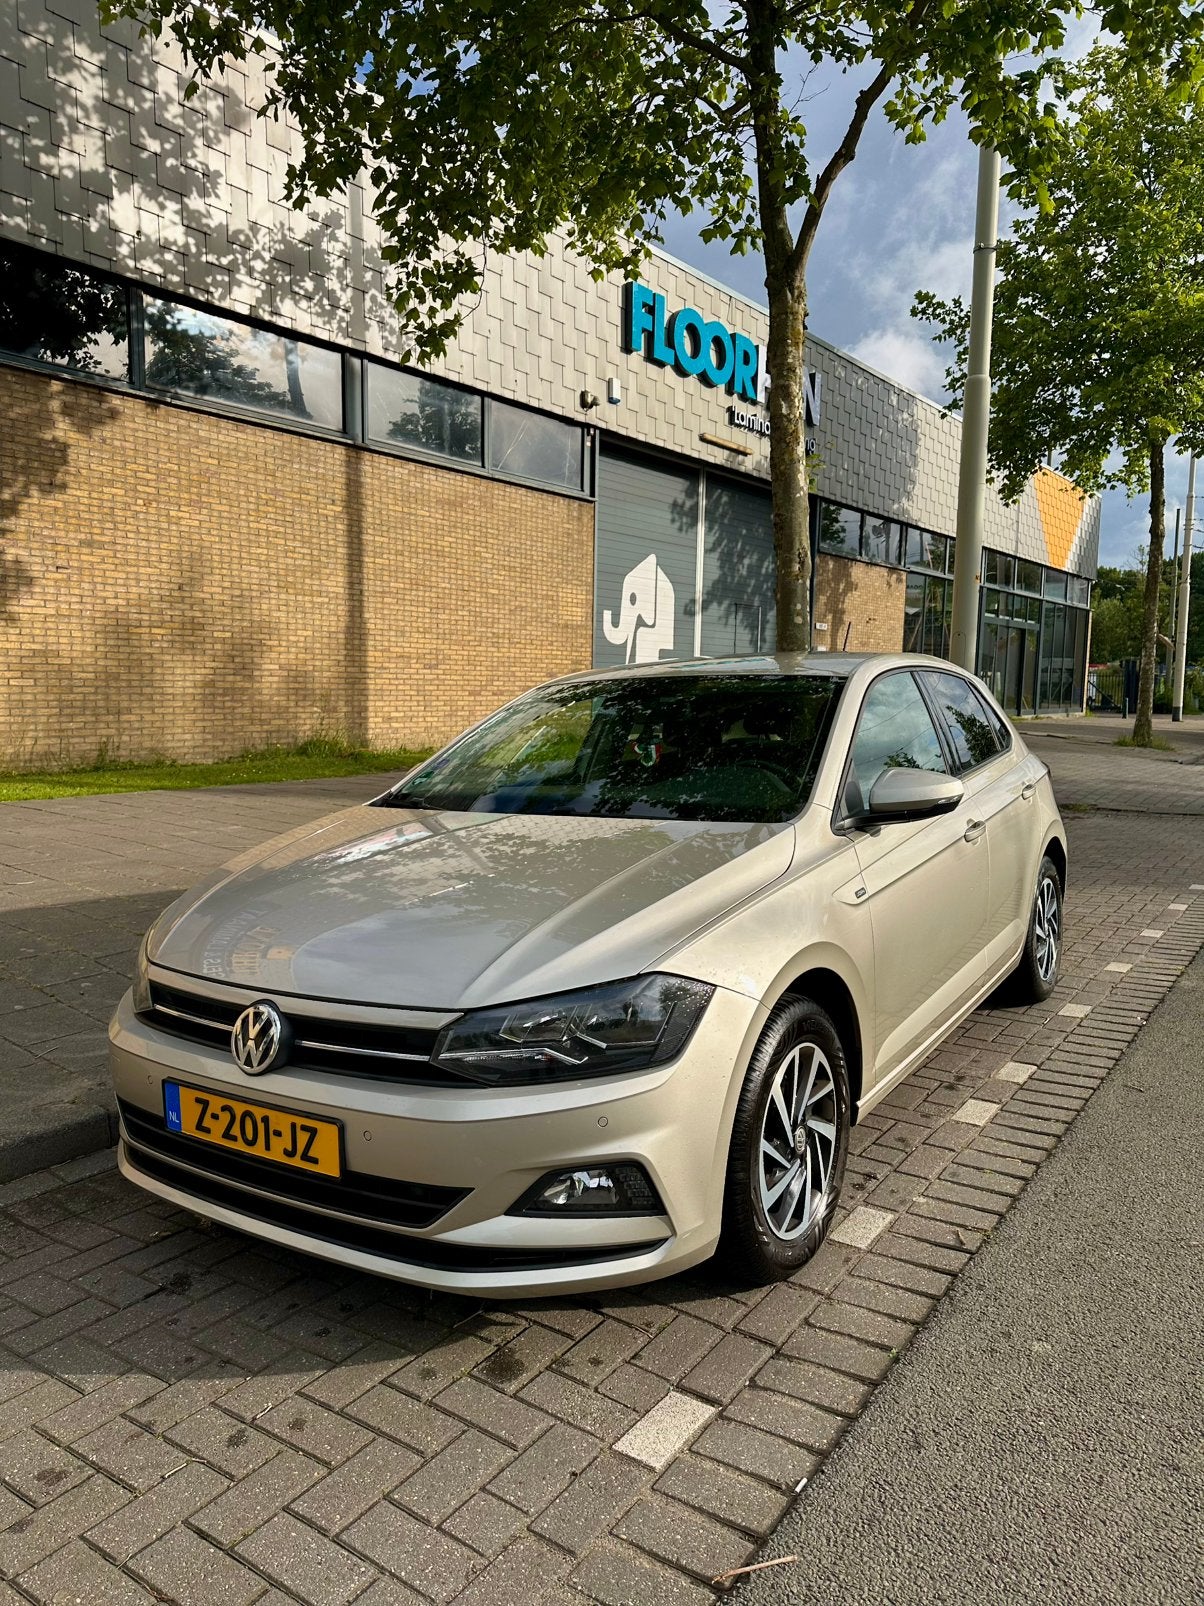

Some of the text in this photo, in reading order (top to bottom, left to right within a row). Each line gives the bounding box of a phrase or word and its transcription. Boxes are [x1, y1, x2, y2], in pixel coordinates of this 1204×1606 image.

[623, 281, 821, 426] FLOORFN
[169, 1111, 179, 1122] NL
[195, 1097, 319, 1165] Z-201-JZ
